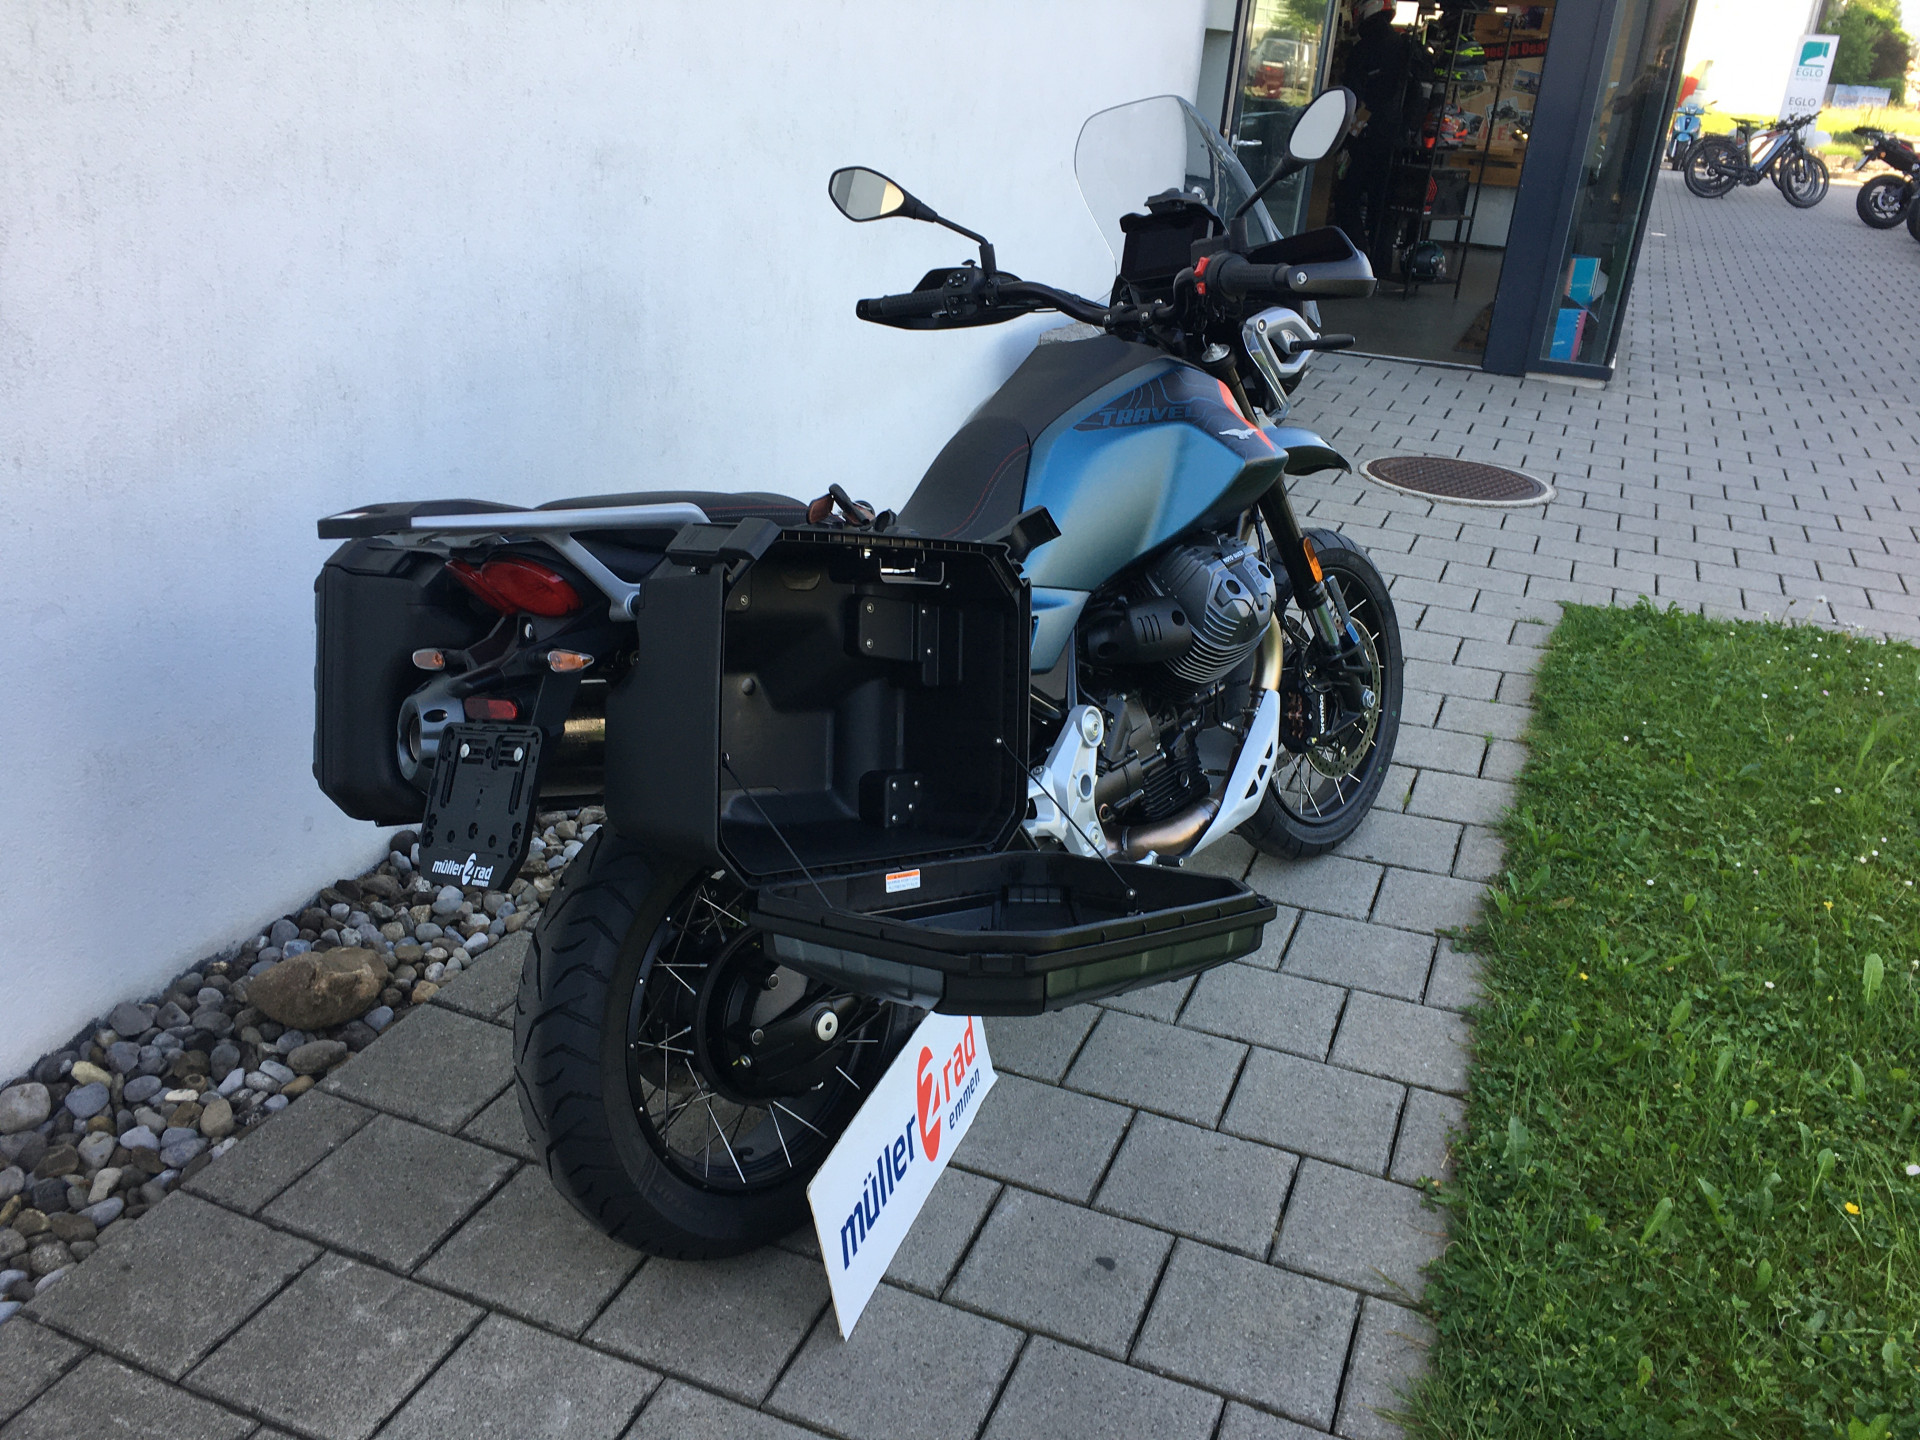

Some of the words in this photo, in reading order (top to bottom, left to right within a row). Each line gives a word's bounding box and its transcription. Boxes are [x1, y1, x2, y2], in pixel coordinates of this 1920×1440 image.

[1484, 43, 1519, 58] pecial
[1795, 67, 1824, 78] EGLO
[1788, 97, 1817, 107] EGLO
[1100, 406, 1201, 426] TRAVEL
[432, 860, 464, 876] müller
[949, 1068, 981, 1130] emmen
[840, 1114, 916, 1271] müller
